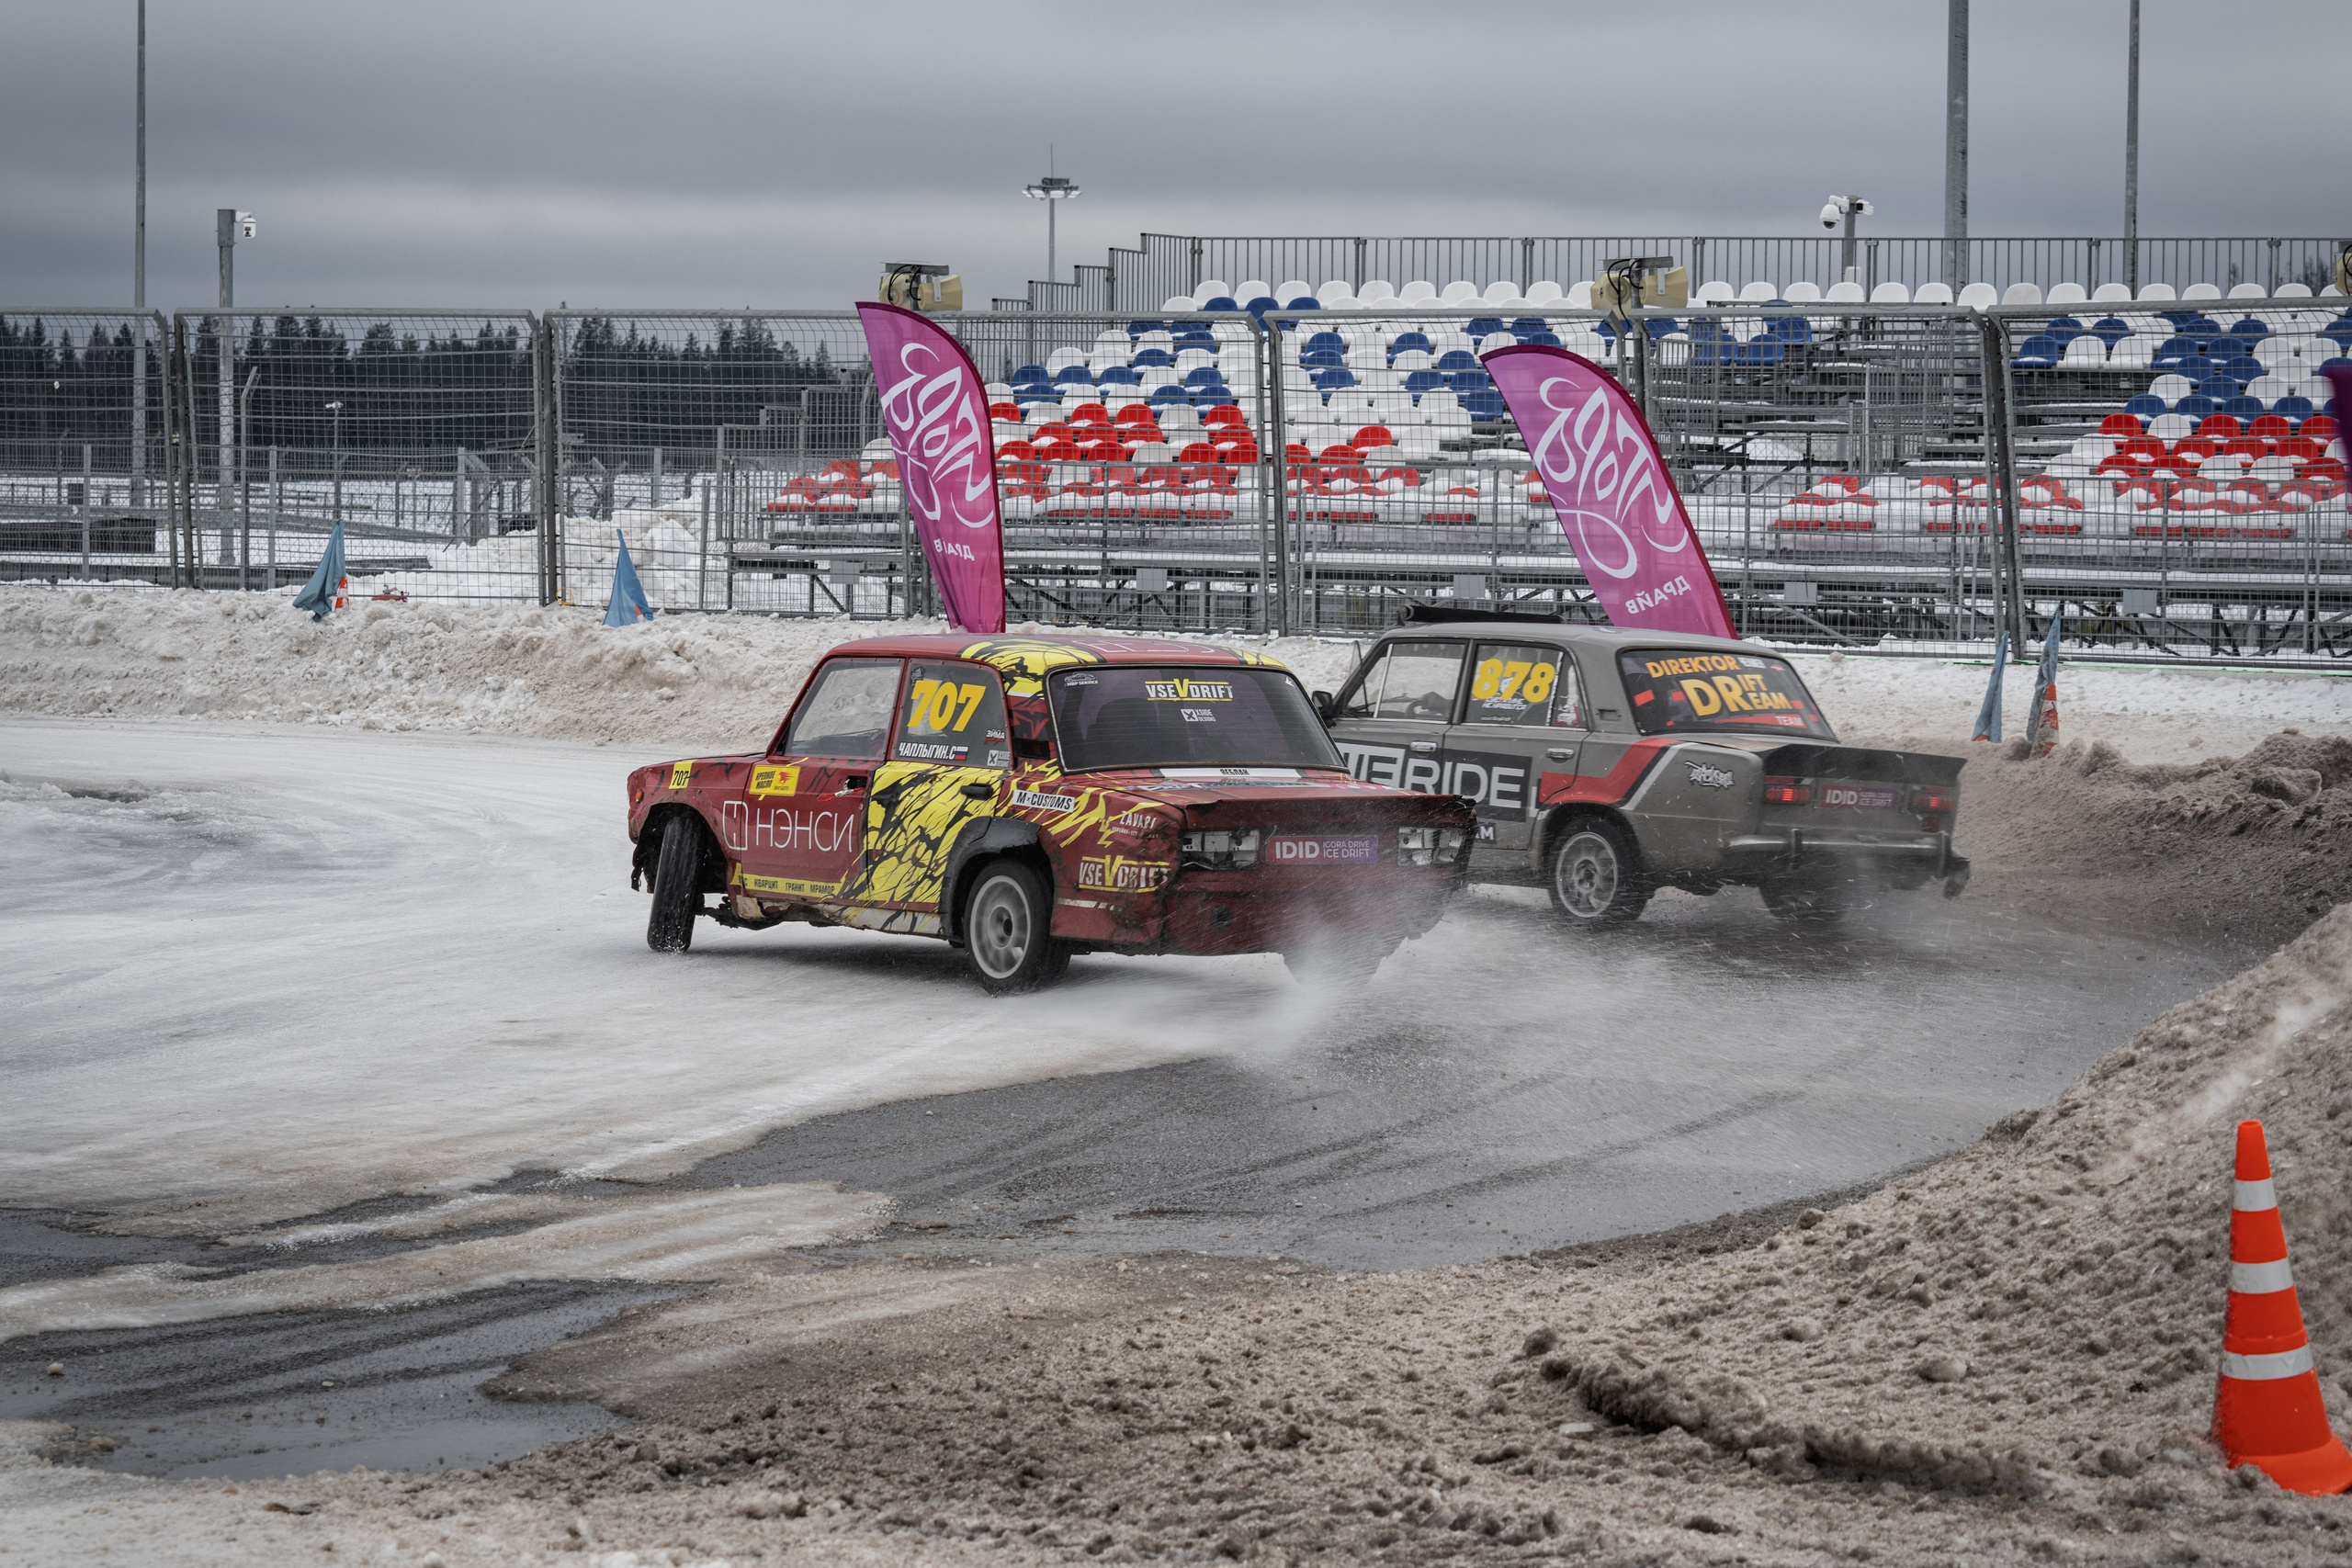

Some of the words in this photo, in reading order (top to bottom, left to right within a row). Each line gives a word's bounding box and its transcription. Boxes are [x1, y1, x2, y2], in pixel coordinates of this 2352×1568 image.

[1645, 655, 1741, 679] DIREKTOR
[1472, 659, 1556, 703] 878
[907, 680, 987, 732] 707
[1774, 716, 1804, 727] TEAM
[899, 742, 956, 761] ЧАПЛЫГИН.С
[672, 770, 690, 786] 707
[1826, 789, 1858, 806] IDID
[756, 808, 854, 852] НЭНСИ
[1275, 841, 1320, 859] IDID
[1323, 840, 1347, 849] IGORA
[1348, 840, 1370, 849] DRIVE
[1323, 849, 1340, 858] ICE
[1341, 848, 1371, 858] DRIFT
[753, 878, 779, 890] КВАРЦИТ
[786, 883, 805, 893] ГРАНИТ
[809, 884, 835, 895] МРАМОР
